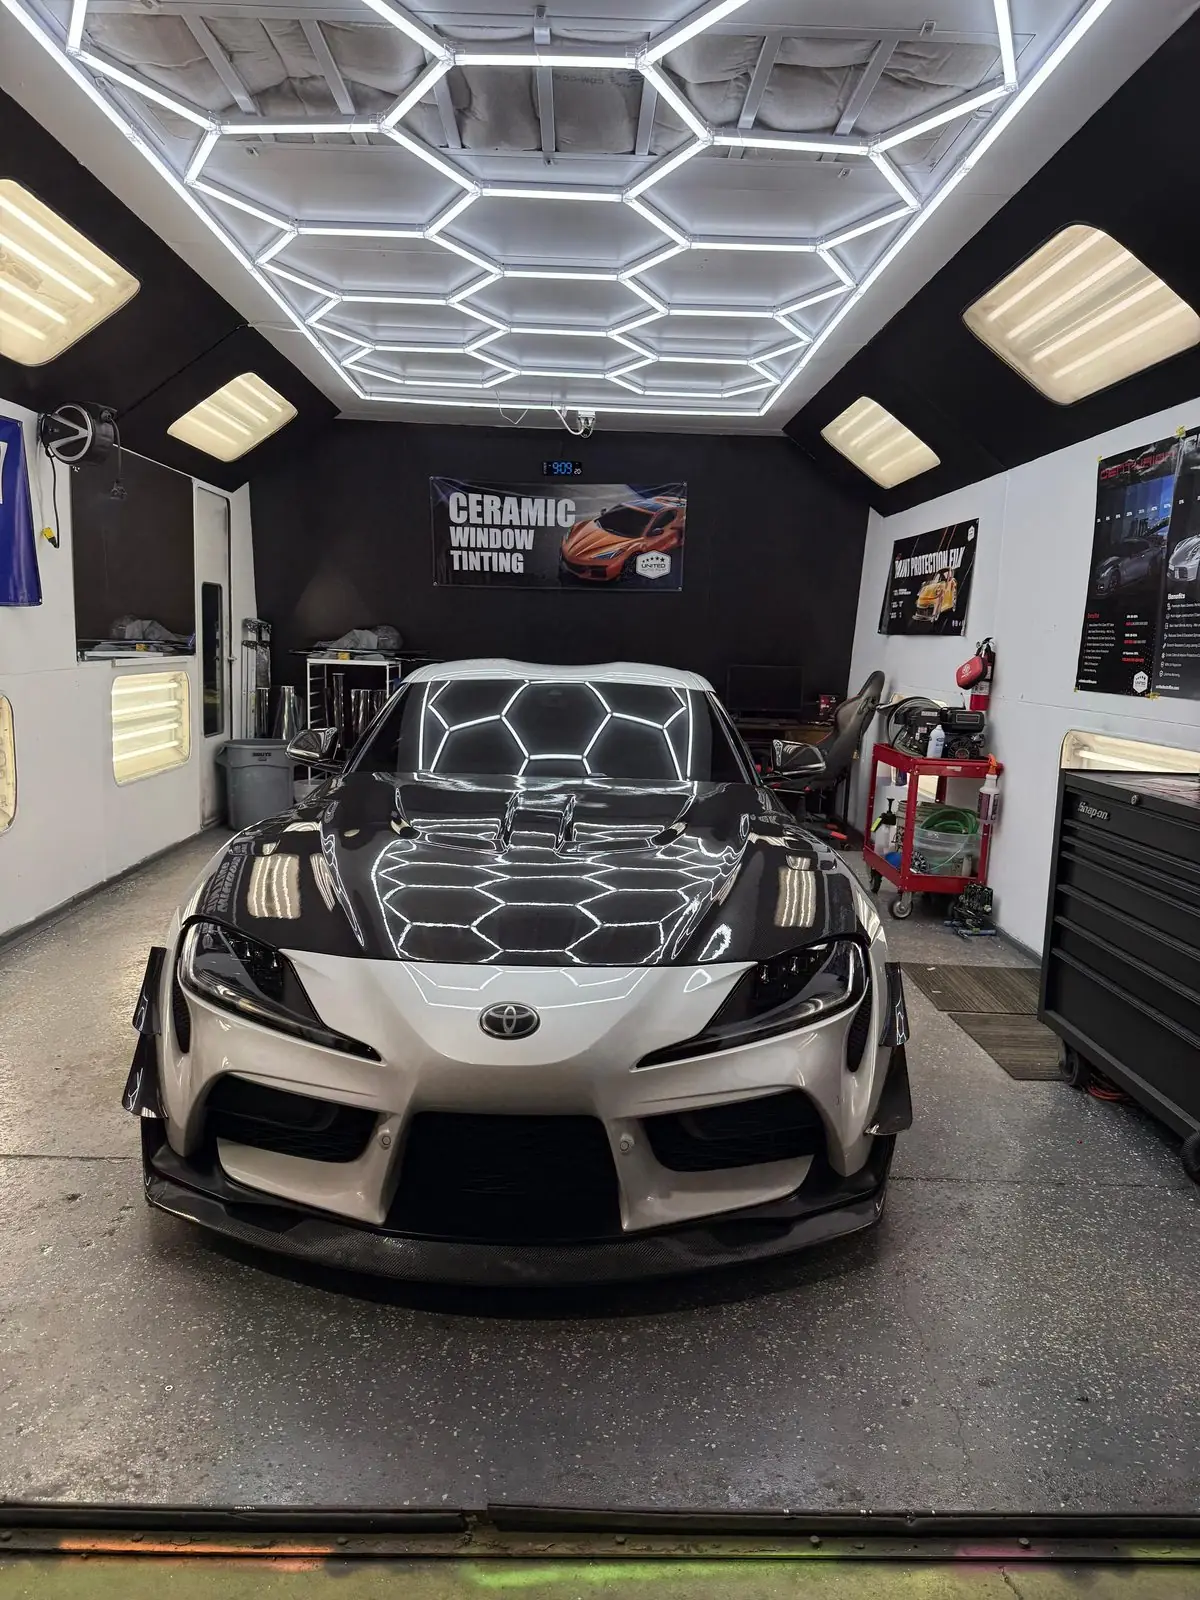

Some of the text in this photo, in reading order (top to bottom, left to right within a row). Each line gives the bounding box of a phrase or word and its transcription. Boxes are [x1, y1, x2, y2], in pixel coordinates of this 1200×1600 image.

[552, 462, 572, 474] 9:09
[449, 492, 576, 527] CERAMIC
[449, 526, 535, 550] WINDOW
[450, 550, 524, 573] TINTING
[910, 550, 948, 577] PROTECTION
